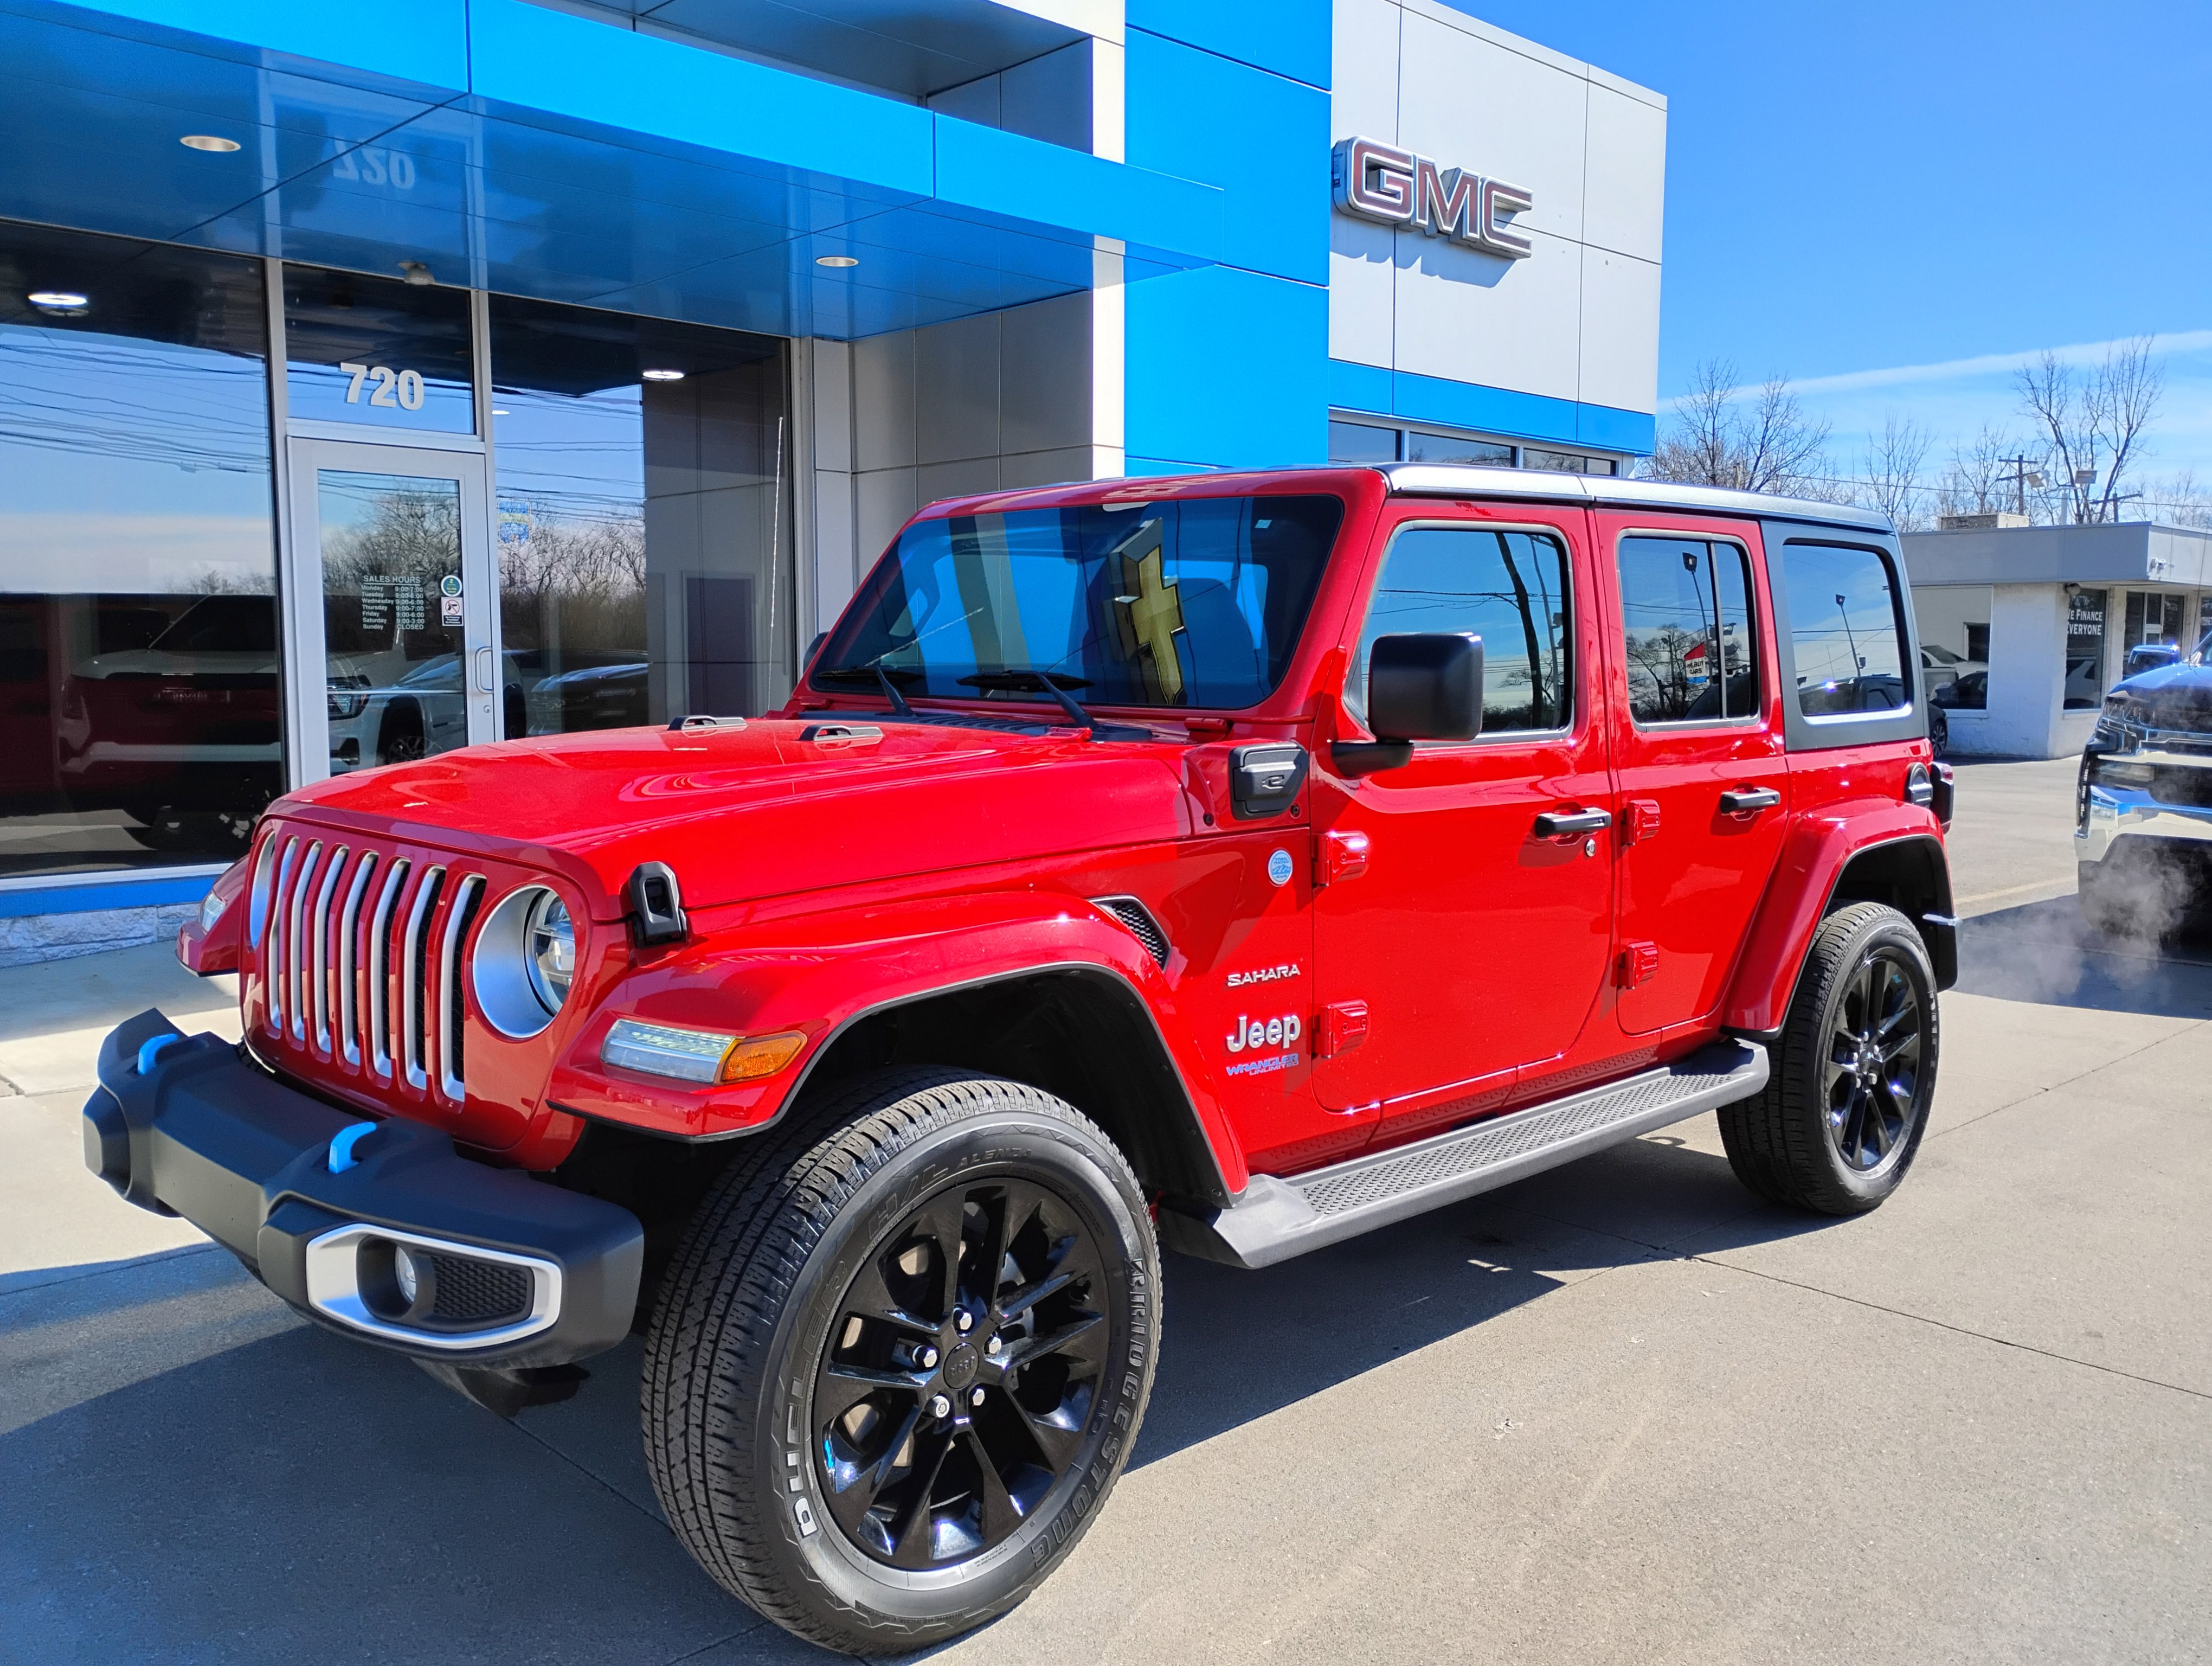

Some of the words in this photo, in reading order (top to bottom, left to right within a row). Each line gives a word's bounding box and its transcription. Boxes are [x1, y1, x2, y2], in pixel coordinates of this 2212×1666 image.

[1333, 135, 1534, 259] GMC
[340, 362, 425, 411] 720
[2068, 608, 2074, 620] E
[2076, 609, 2102, 621] FINANCE
[1227, 964, 1301, 987] SAHARA
[1226, 1015, 1301, 1053] Jeep
[1226, 1053, 1299, 1076] WRANGLER
